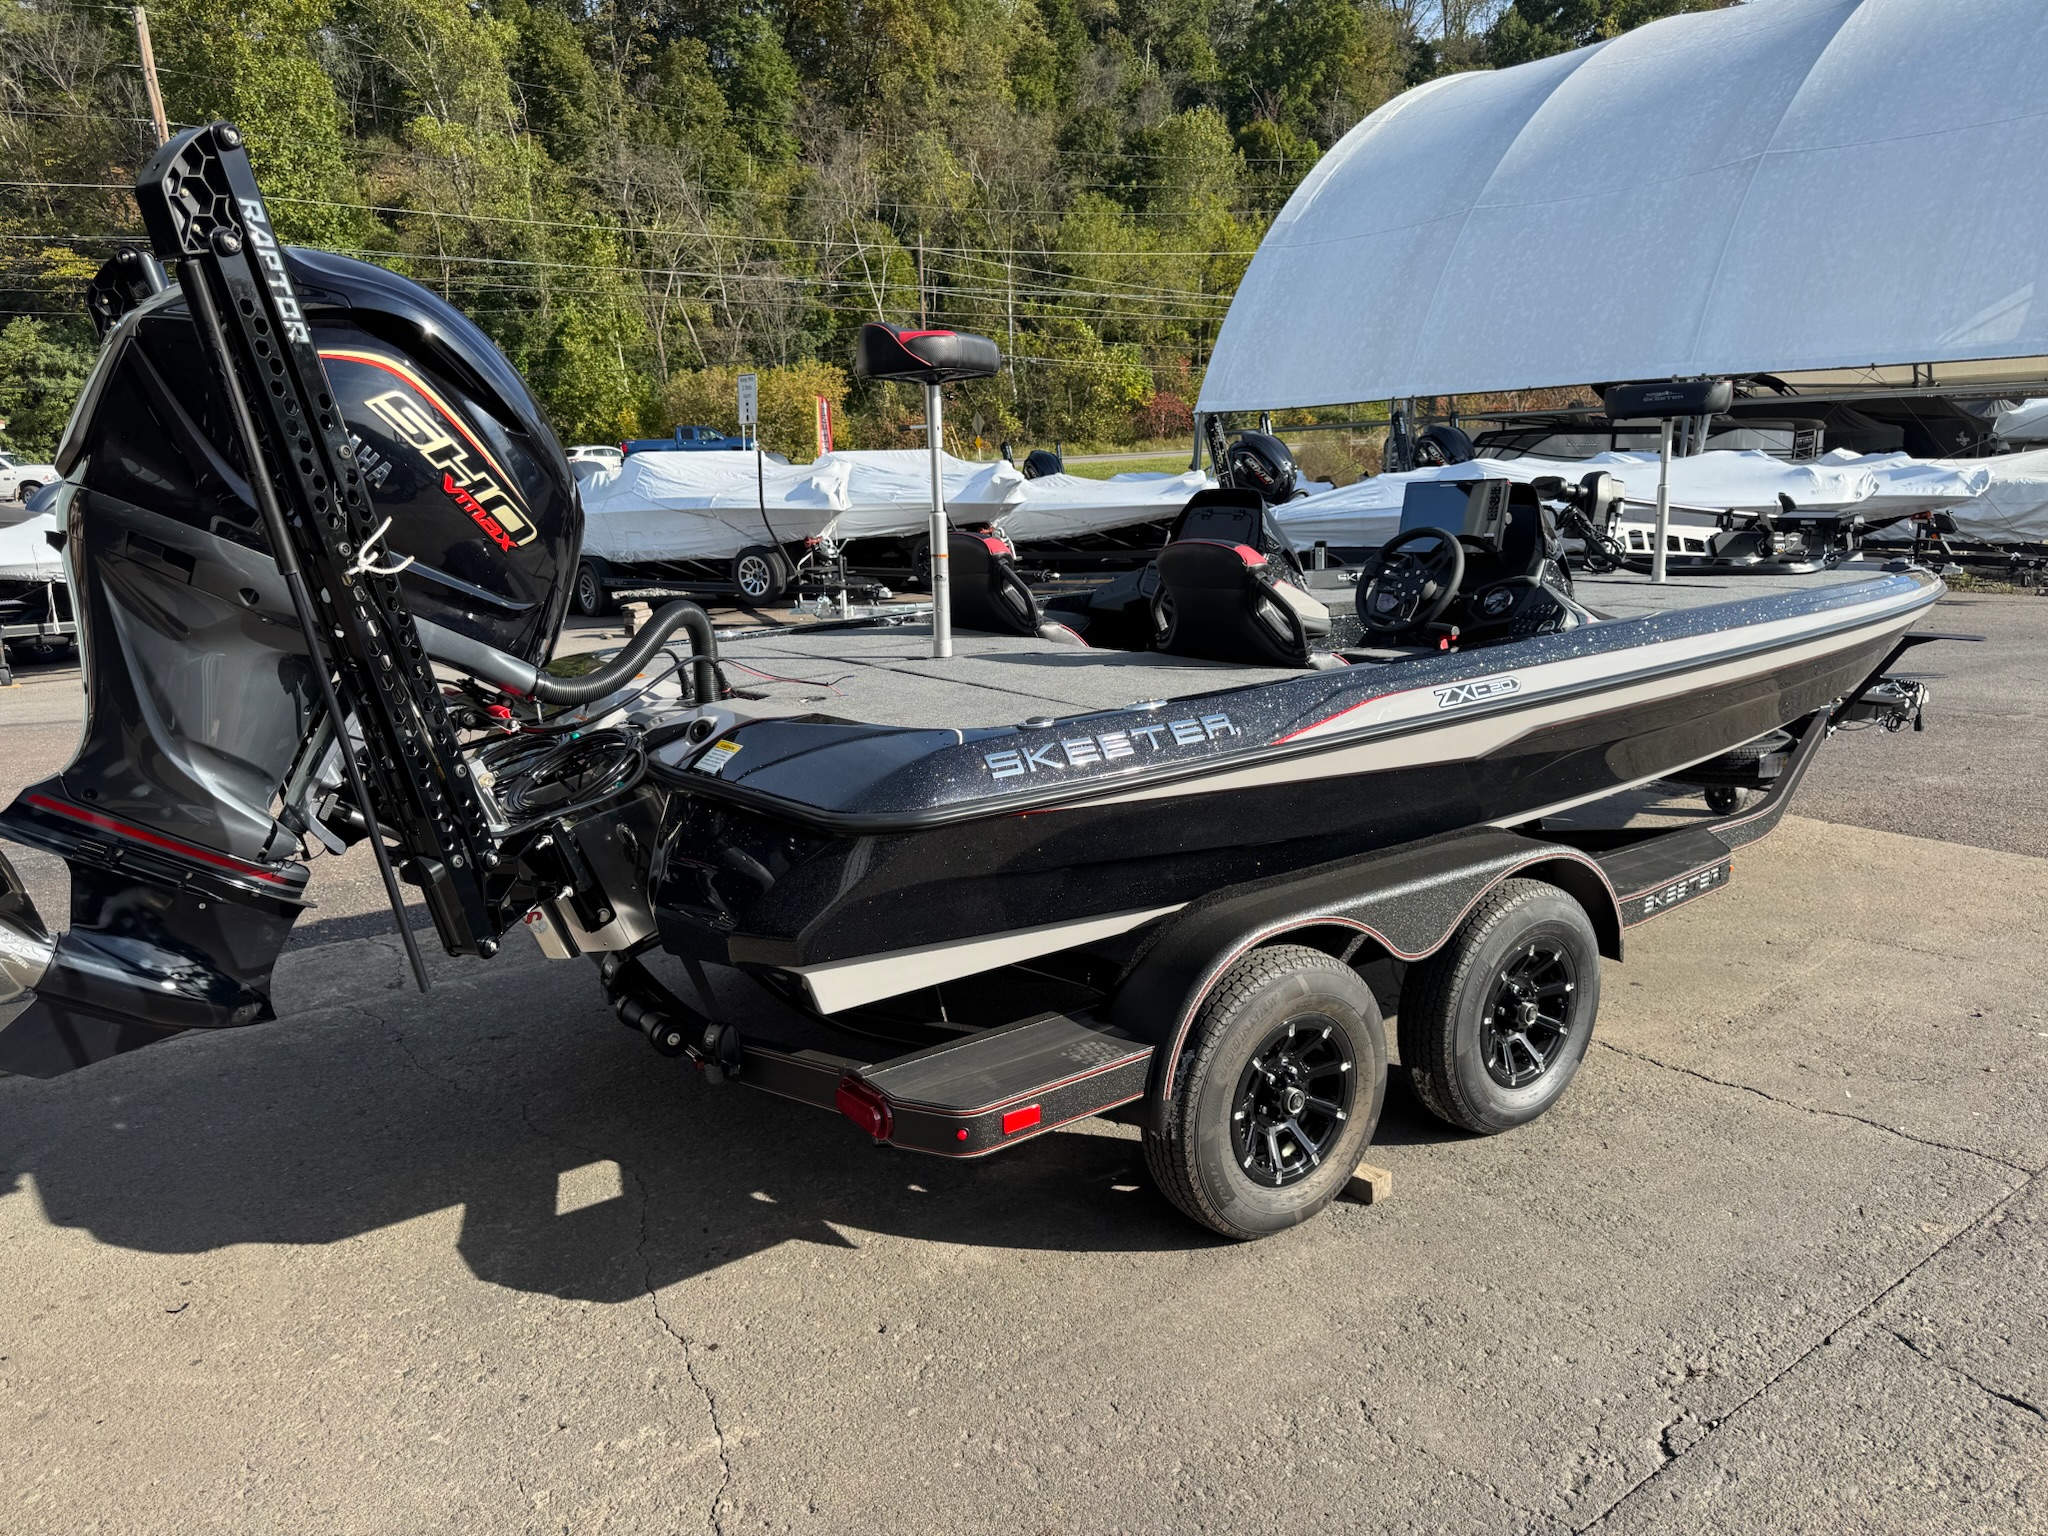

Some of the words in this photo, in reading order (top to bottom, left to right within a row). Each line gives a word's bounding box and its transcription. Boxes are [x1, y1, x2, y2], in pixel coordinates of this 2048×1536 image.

[238, 198, 310, 344] RAPTOR
[364, 390, 538, 547] SHO
[984, 703, 1237, 779] SKEETER
[1643, 866, 1722, 913] SKEETER
